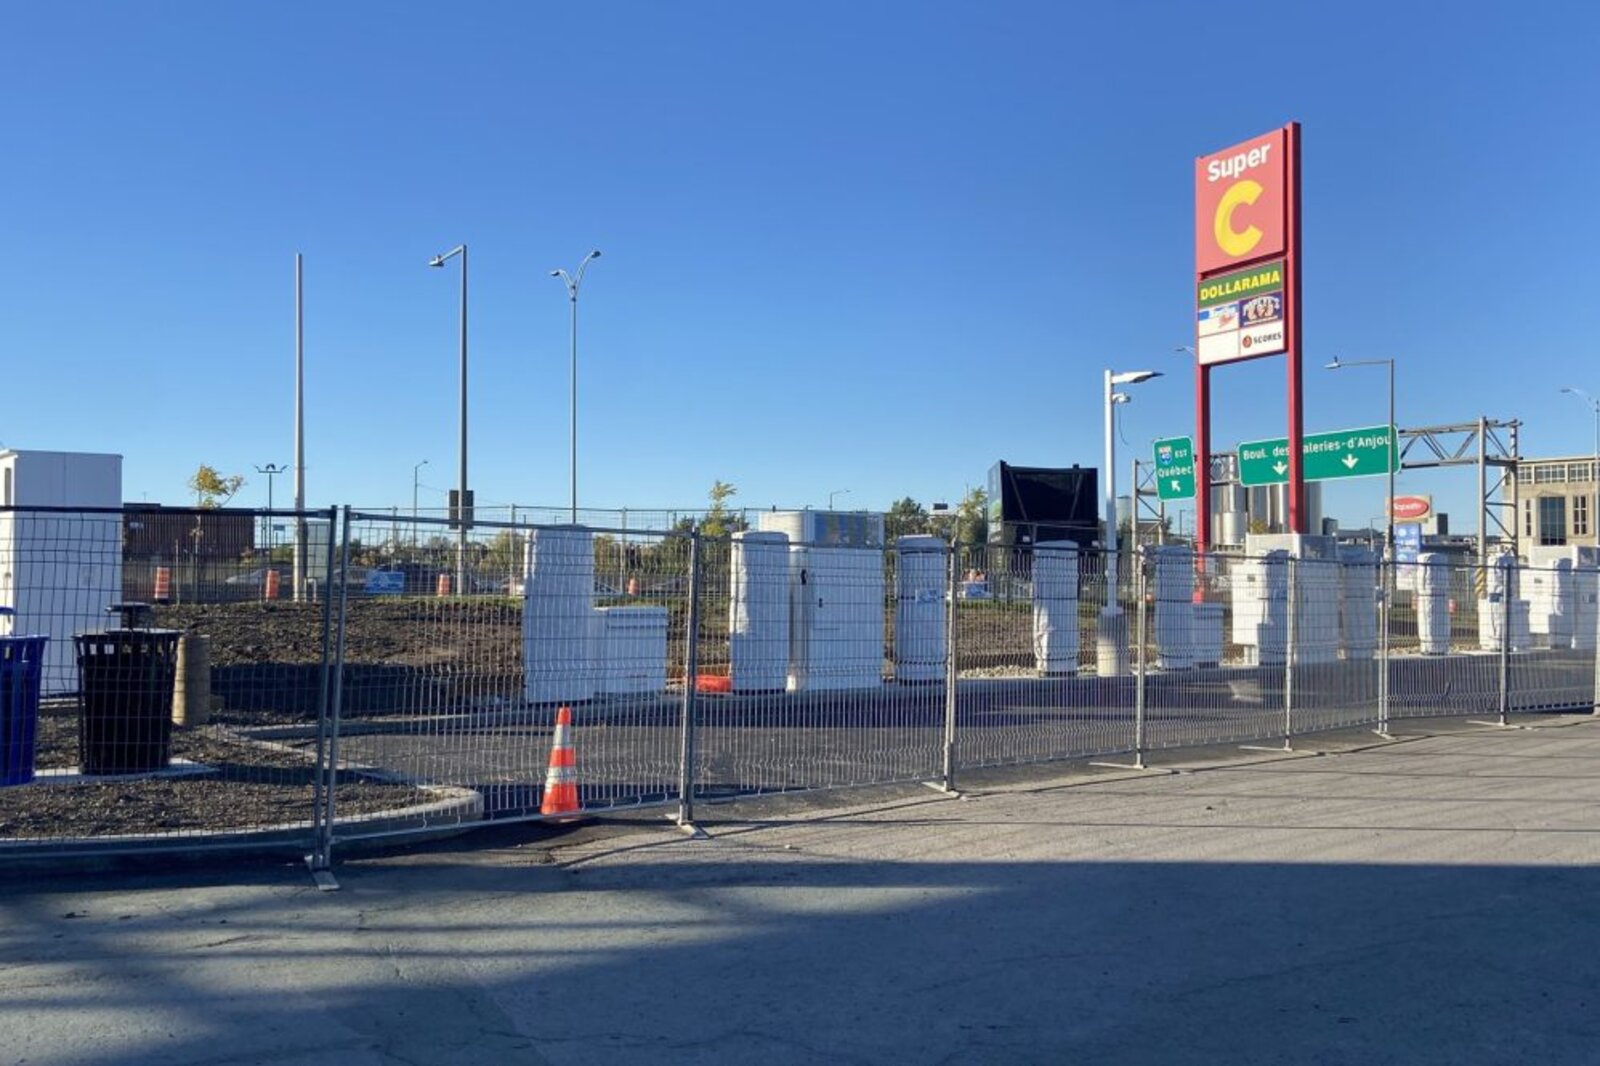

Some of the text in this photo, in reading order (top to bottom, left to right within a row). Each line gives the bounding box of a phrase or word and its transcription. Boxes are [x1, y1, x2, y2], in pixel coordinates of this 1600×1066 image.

[1207, 143, 1271, 182] Super
[1214, 180, 1263, 257] C
[1200, 270, 1281, 301] DOLLARAMA
[1253, 332, 1282, 346] SCORES
[1174, 449, 1187, 458] EST
[1243, 434, 1391, 460] Boul. des aleries-d'Anjou
[1157, 465, 1193, 478] Québec
